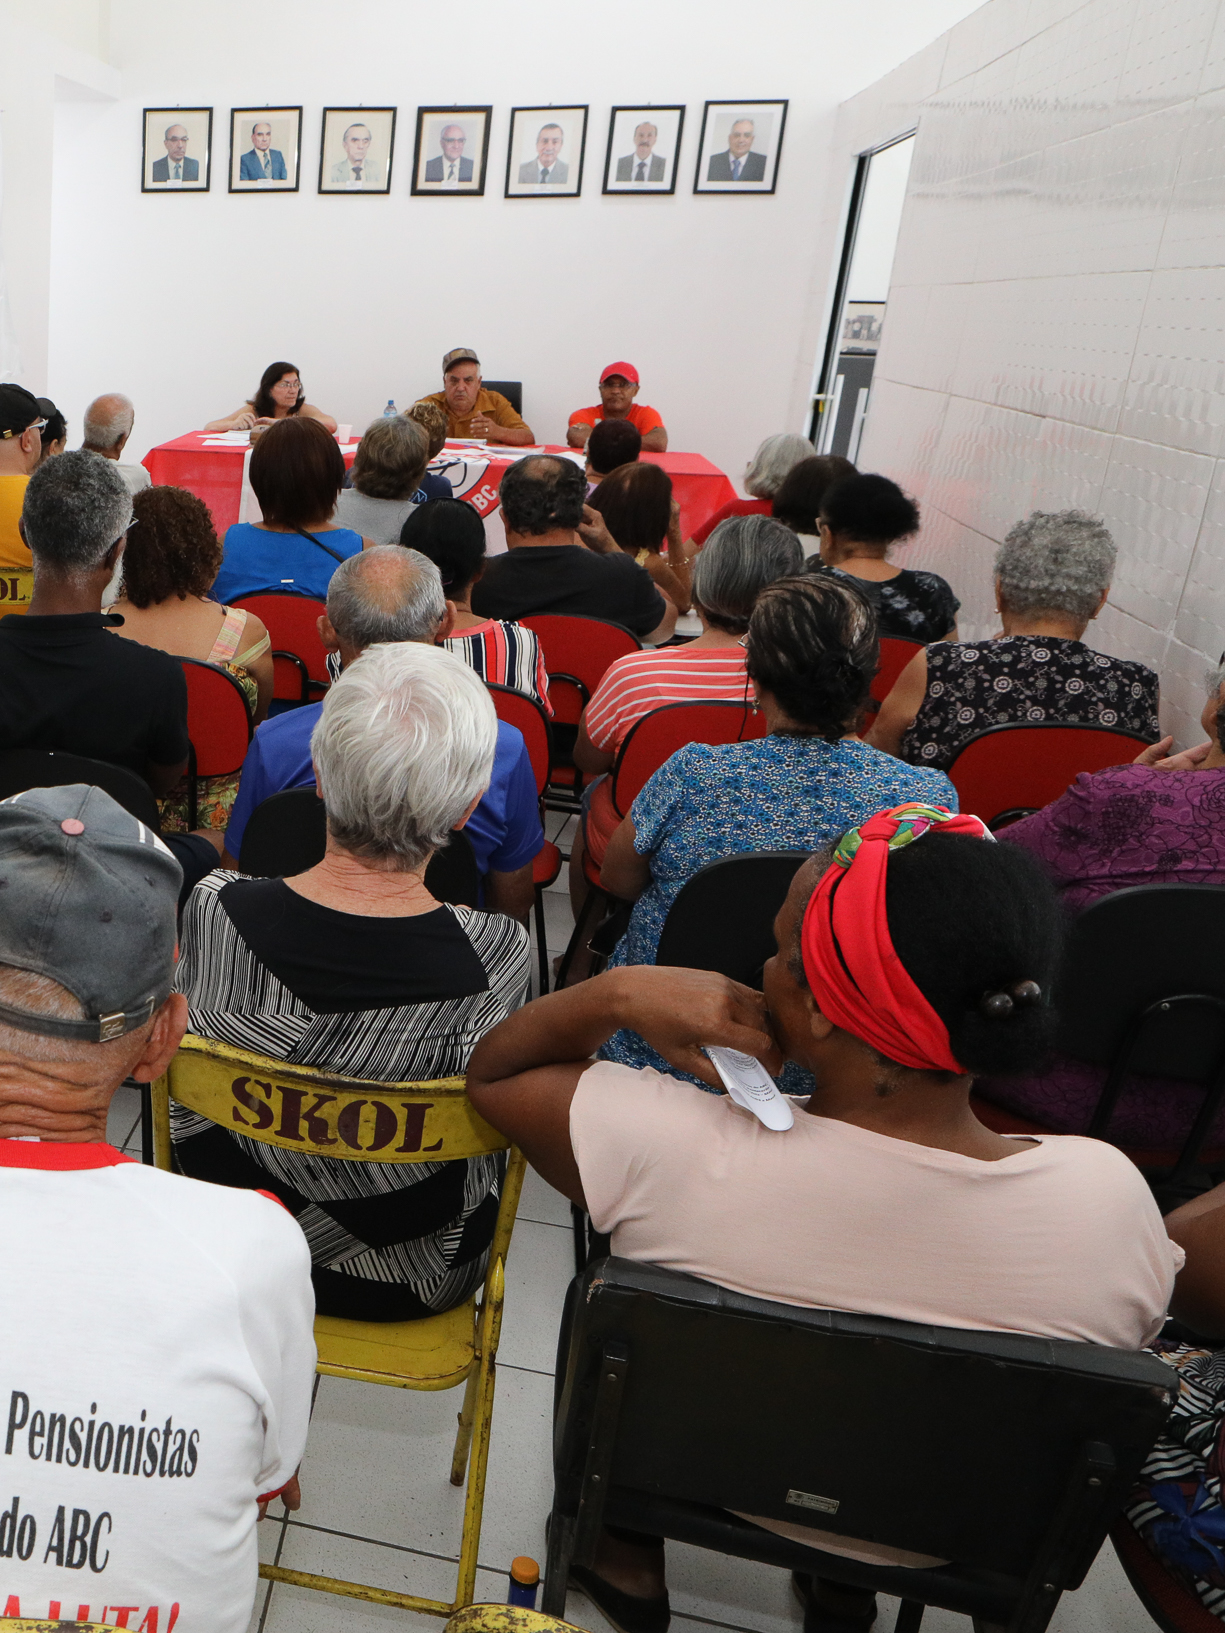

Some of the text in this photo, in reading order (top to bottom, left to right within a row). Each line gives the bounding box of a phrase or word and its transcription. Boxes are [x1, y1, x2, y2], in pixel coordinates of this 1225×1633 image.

[231, 1076, 444, 1153] SKOL
[5, 1390, 200, 1478] Pensionistas
[43, 1505, 112, 1573] ABC
